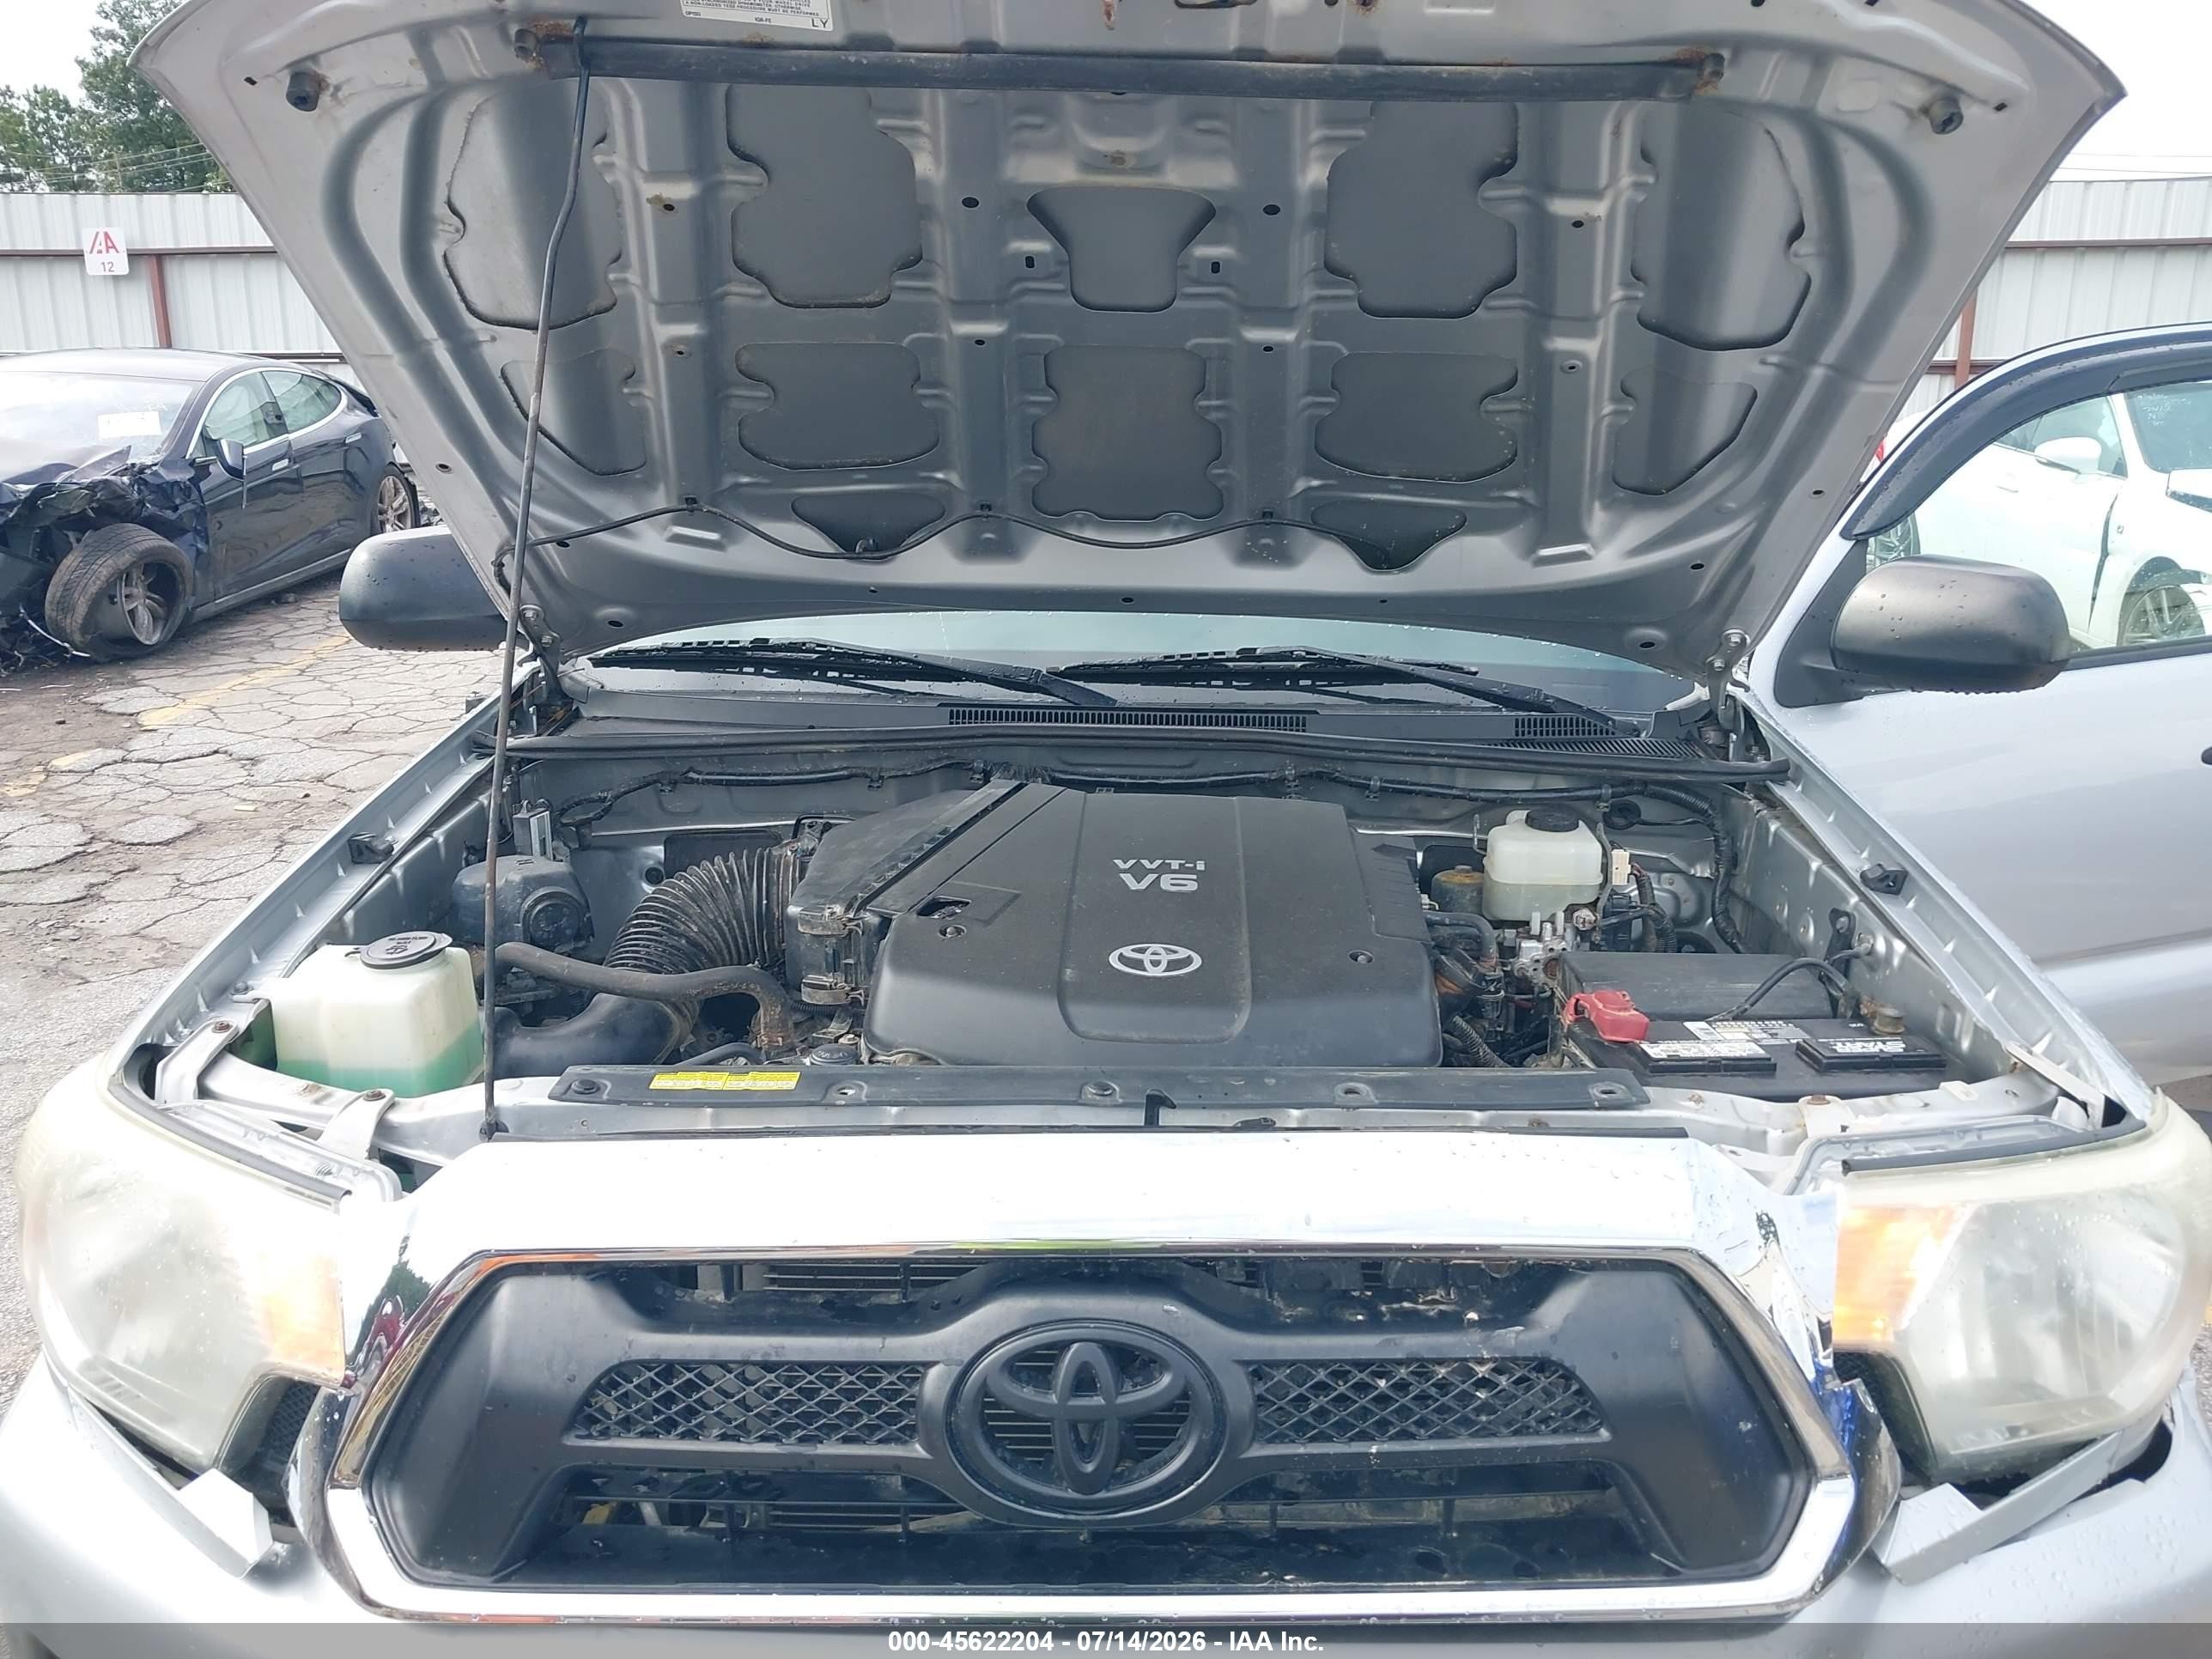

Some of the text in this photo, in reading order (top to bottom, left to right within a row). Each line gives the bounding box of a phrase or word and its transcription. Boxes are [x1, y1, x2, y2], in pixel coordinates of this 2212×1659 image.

[100, 261, 116, 272] 12
[1113, 859, 1205, 870] VVT-i
[1119, 872, 1199, 891] V6
